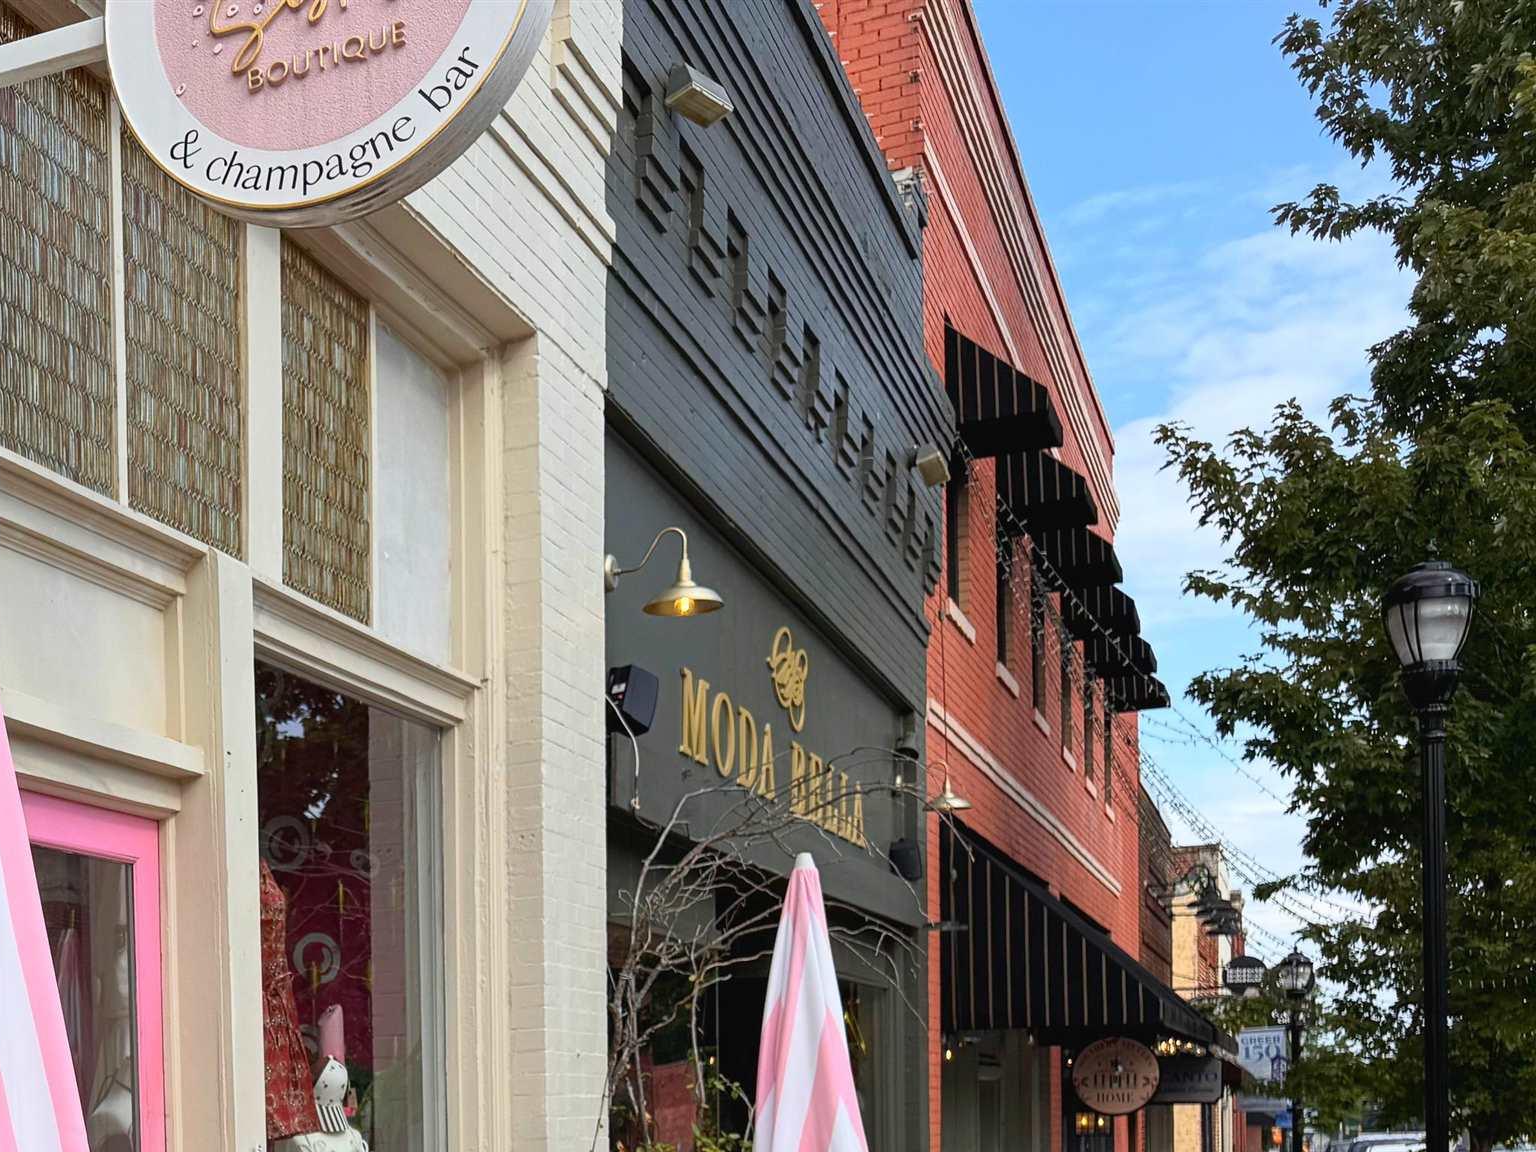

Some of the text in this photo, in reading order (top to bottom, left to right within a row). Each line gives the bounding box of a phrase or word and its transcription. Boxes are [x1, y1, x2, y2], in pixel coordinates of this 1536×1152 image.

[247, 21, 408, 94] BOUTIQUE
[169, 46, 480, 196] & champagne bar
[678, 666, 777, 802] MODA
[1244, 1044, 1281, 1062] 150
